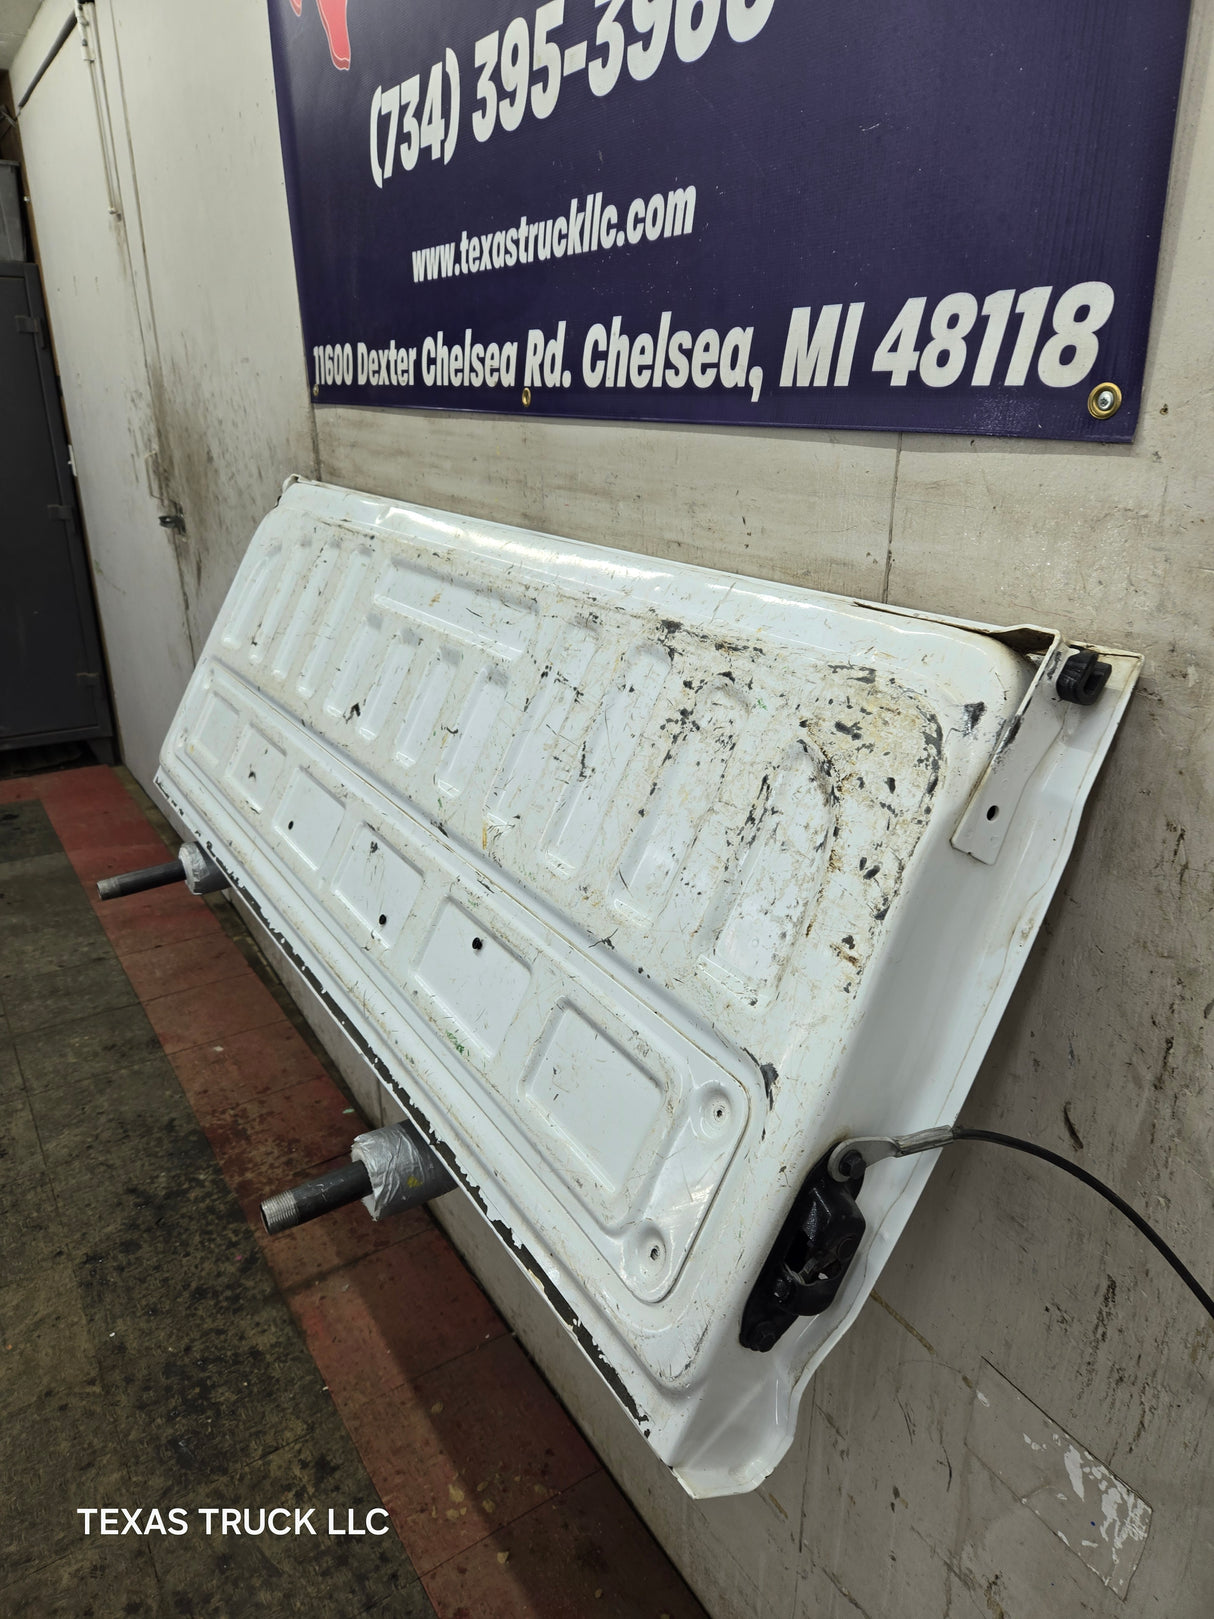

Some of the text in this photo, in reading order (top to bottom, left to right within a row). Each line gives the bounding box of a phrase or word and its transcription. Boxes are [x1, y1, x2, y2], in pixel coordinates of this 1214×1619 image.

[370, 0, 775, 189] (734) 395-39
[411, 185, 697, 283] www.texastruckllc.com
[313, 281, 1115, 402] 11600 Dexter Chelsea Rd. Chelsea, MI 48118
